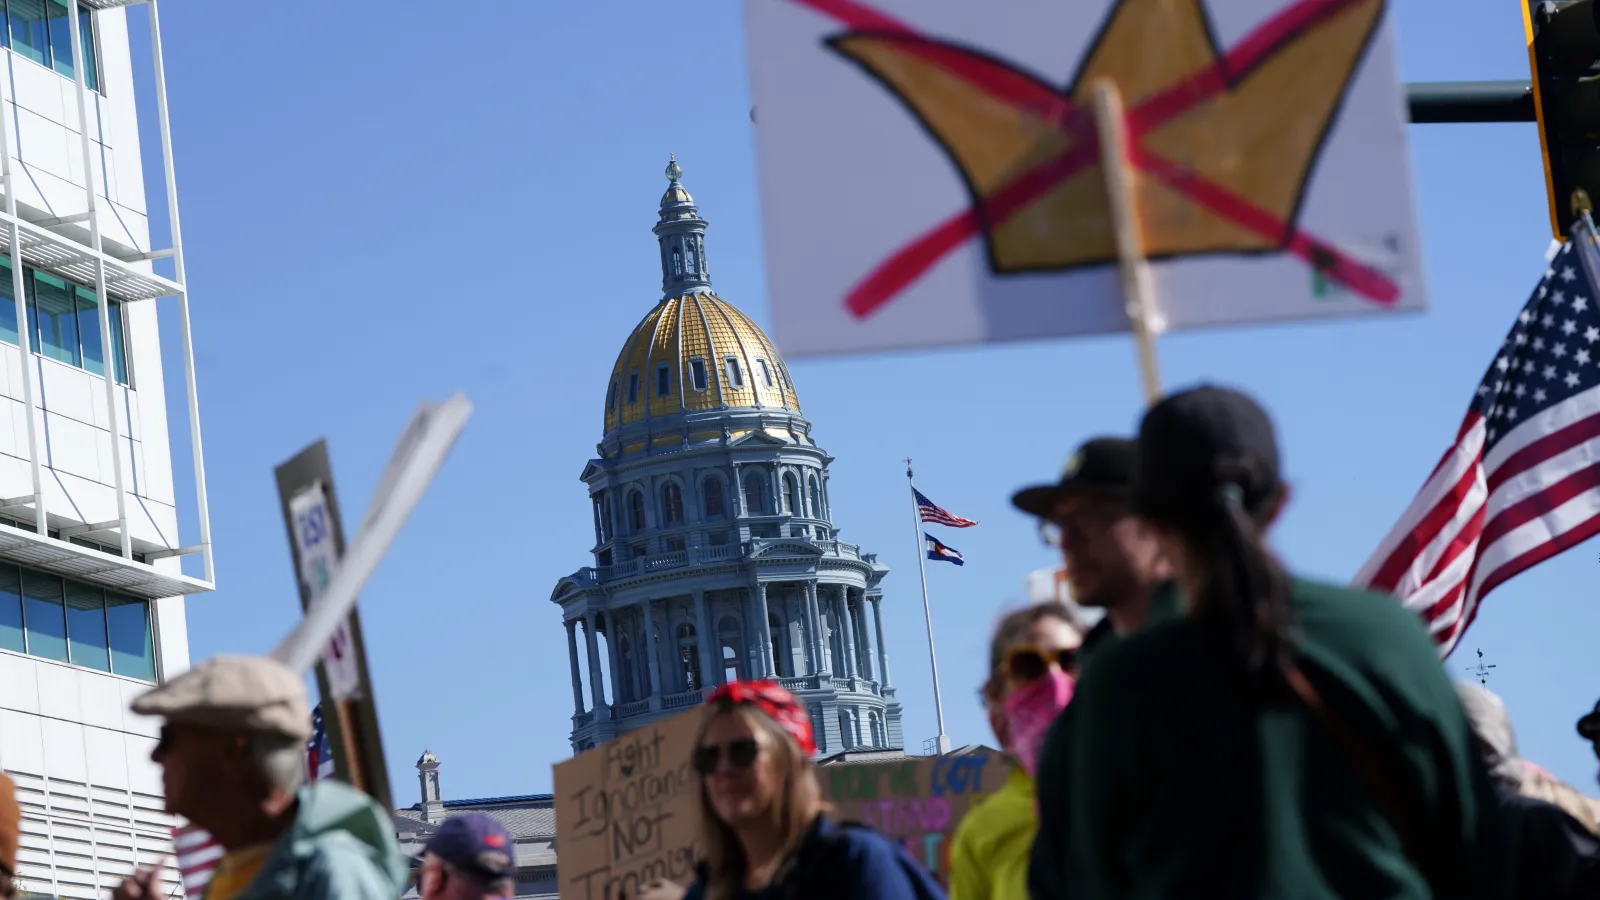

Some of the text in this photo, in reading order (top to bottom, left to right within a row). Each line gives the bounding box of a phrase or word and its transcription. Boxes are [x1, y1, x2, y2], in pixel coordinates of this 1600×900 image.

[568, 760, 692, 836] Ignoranc
[931, 755, 989, 796] GOT
[611, 803, 675, 862] NOT
